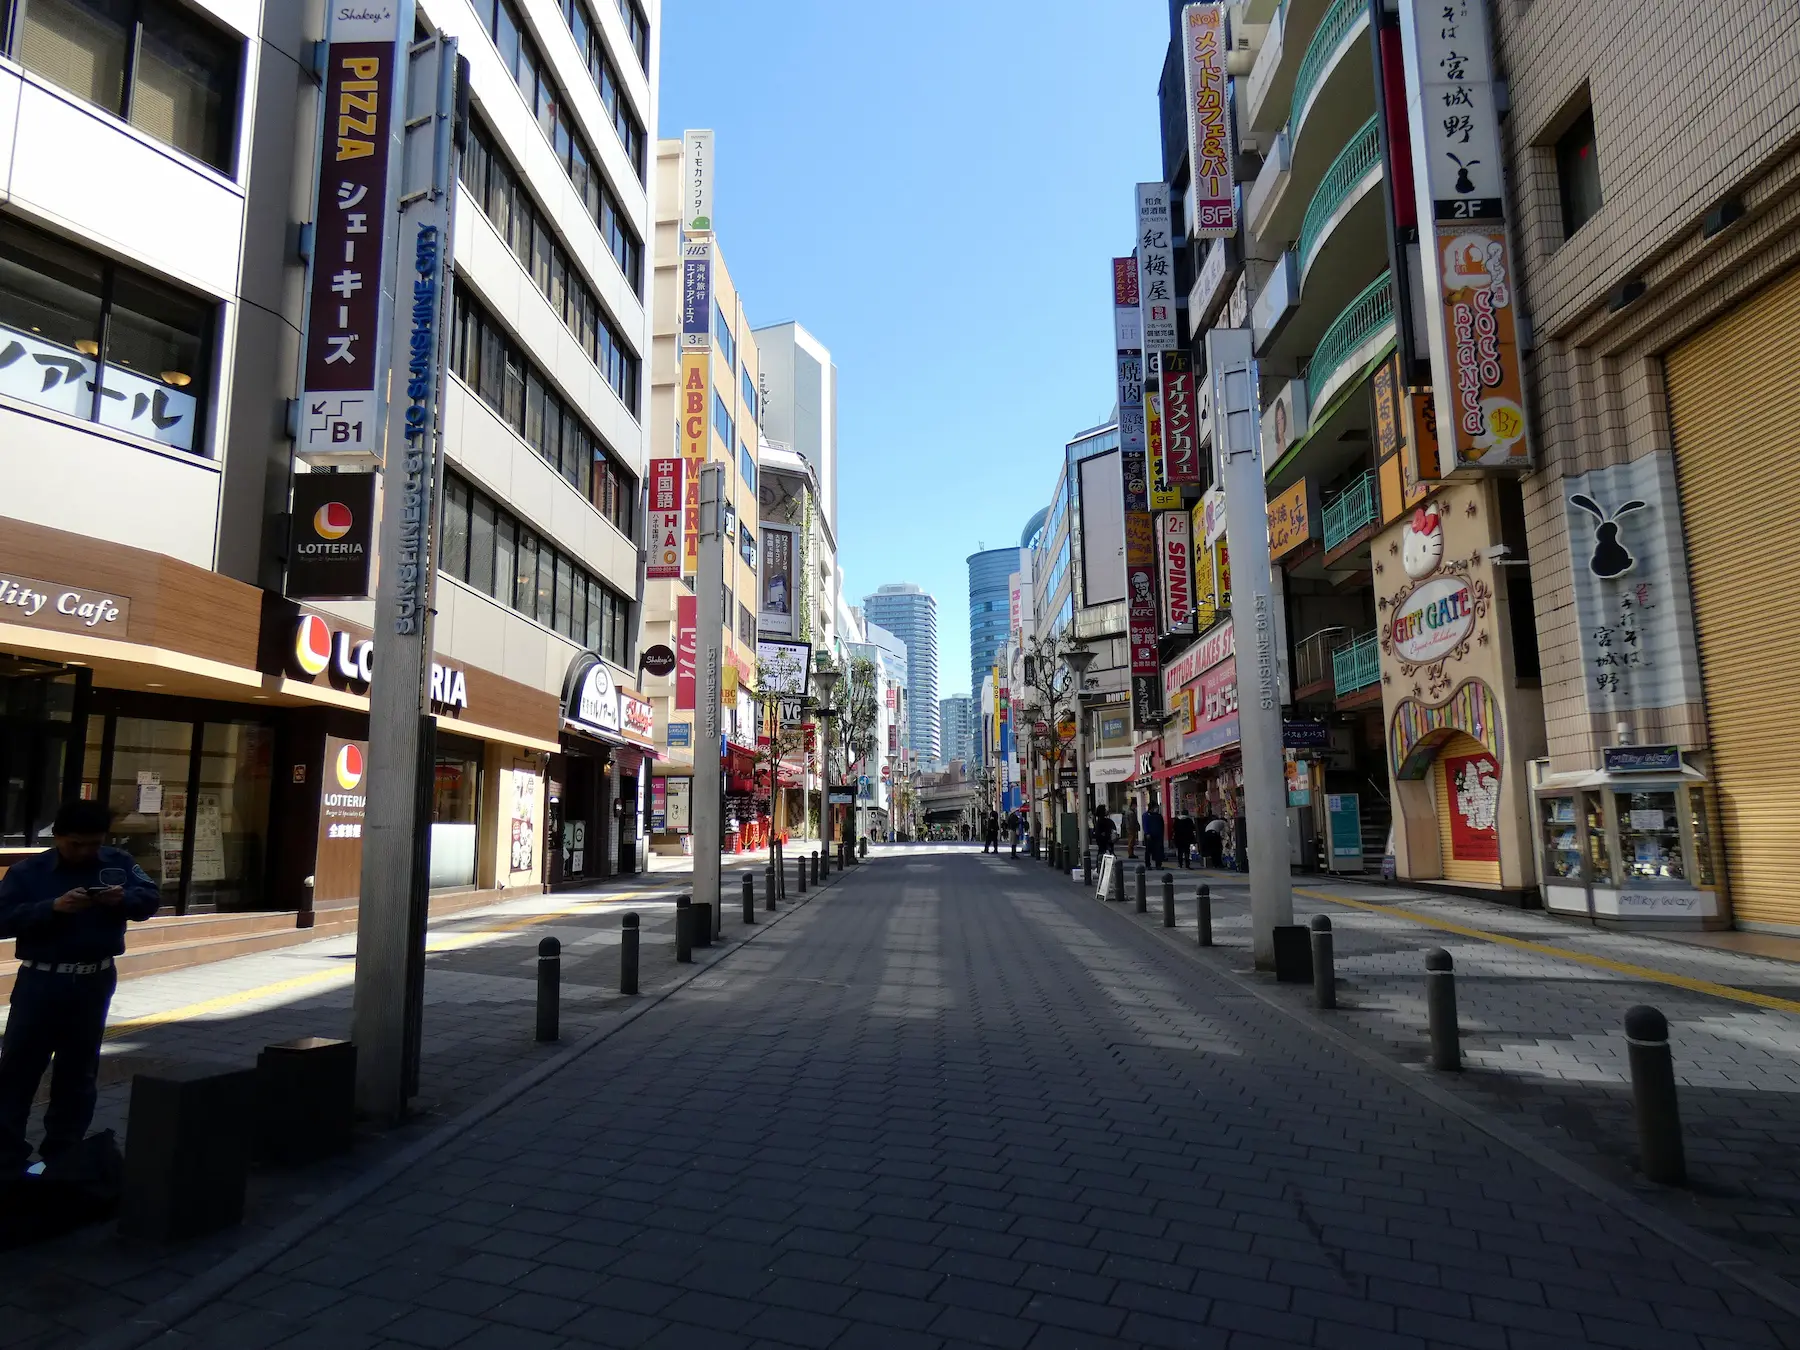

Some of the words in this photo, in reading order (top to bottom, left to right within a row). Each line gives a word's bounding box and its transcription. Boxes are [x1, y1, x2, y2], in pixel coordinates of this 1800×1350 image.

[338, 8, 391, 23] Shakey's
[336, 57, 379, 161] PIZZA
[1194, 31, 1228, 197] メイドカフェ&バー
[1439, 51, 1474, 144] 宮城野
[694, 141, 703, 215] スーモカウンター
[1145, 197, 1161, 206] 和食
[1200, 207, 1233, 224] 5F
[1453, 200, 1481, 217] 2F
[414, 220, 440, 275] CITY
[687, 246, 708, 256] HIS
[1143, 228, 1170, 301] 紀梅屋
[325, 182, 369, 365] シェーキーズ
[696, 264, 706, 300] 海外旅行
[407, 278, 435, 400] SUNSHINE
[688, 334, 703, 345] 3F
[1165, 353, 1189, 371] 7F
[1473, 290, 1501, 384] COCO
[1119, 362, 1142, 402] 焼肉
[332, 421, 364, 443] B1
[404, 405, 427, 440] TO
[1169, 374, 1194, 474] イケメンカフェ
[1491, 409, 1519, 438] B1
[657, 459, 674, 509] 中国語
[297, 543, 364, 554] LOTTERIA
[1169, 517, 1184, 532] 2F
[1168, 541, 1189, 625] SPINNS
[57, 592, 120, 627] Cafe
[1131, 608, 1154, 617] KFC
[1393, 608, 1423, 644] GIFT
[1425, 587, 1471, 630] GATE
[338, 631, 468, 709] LORIA
[1255, 633, 1273, 711] SUNSHINE
[1593, 626, 1620, 693] 宮城野
[704, 678, 718, 739] SUNSHINE
